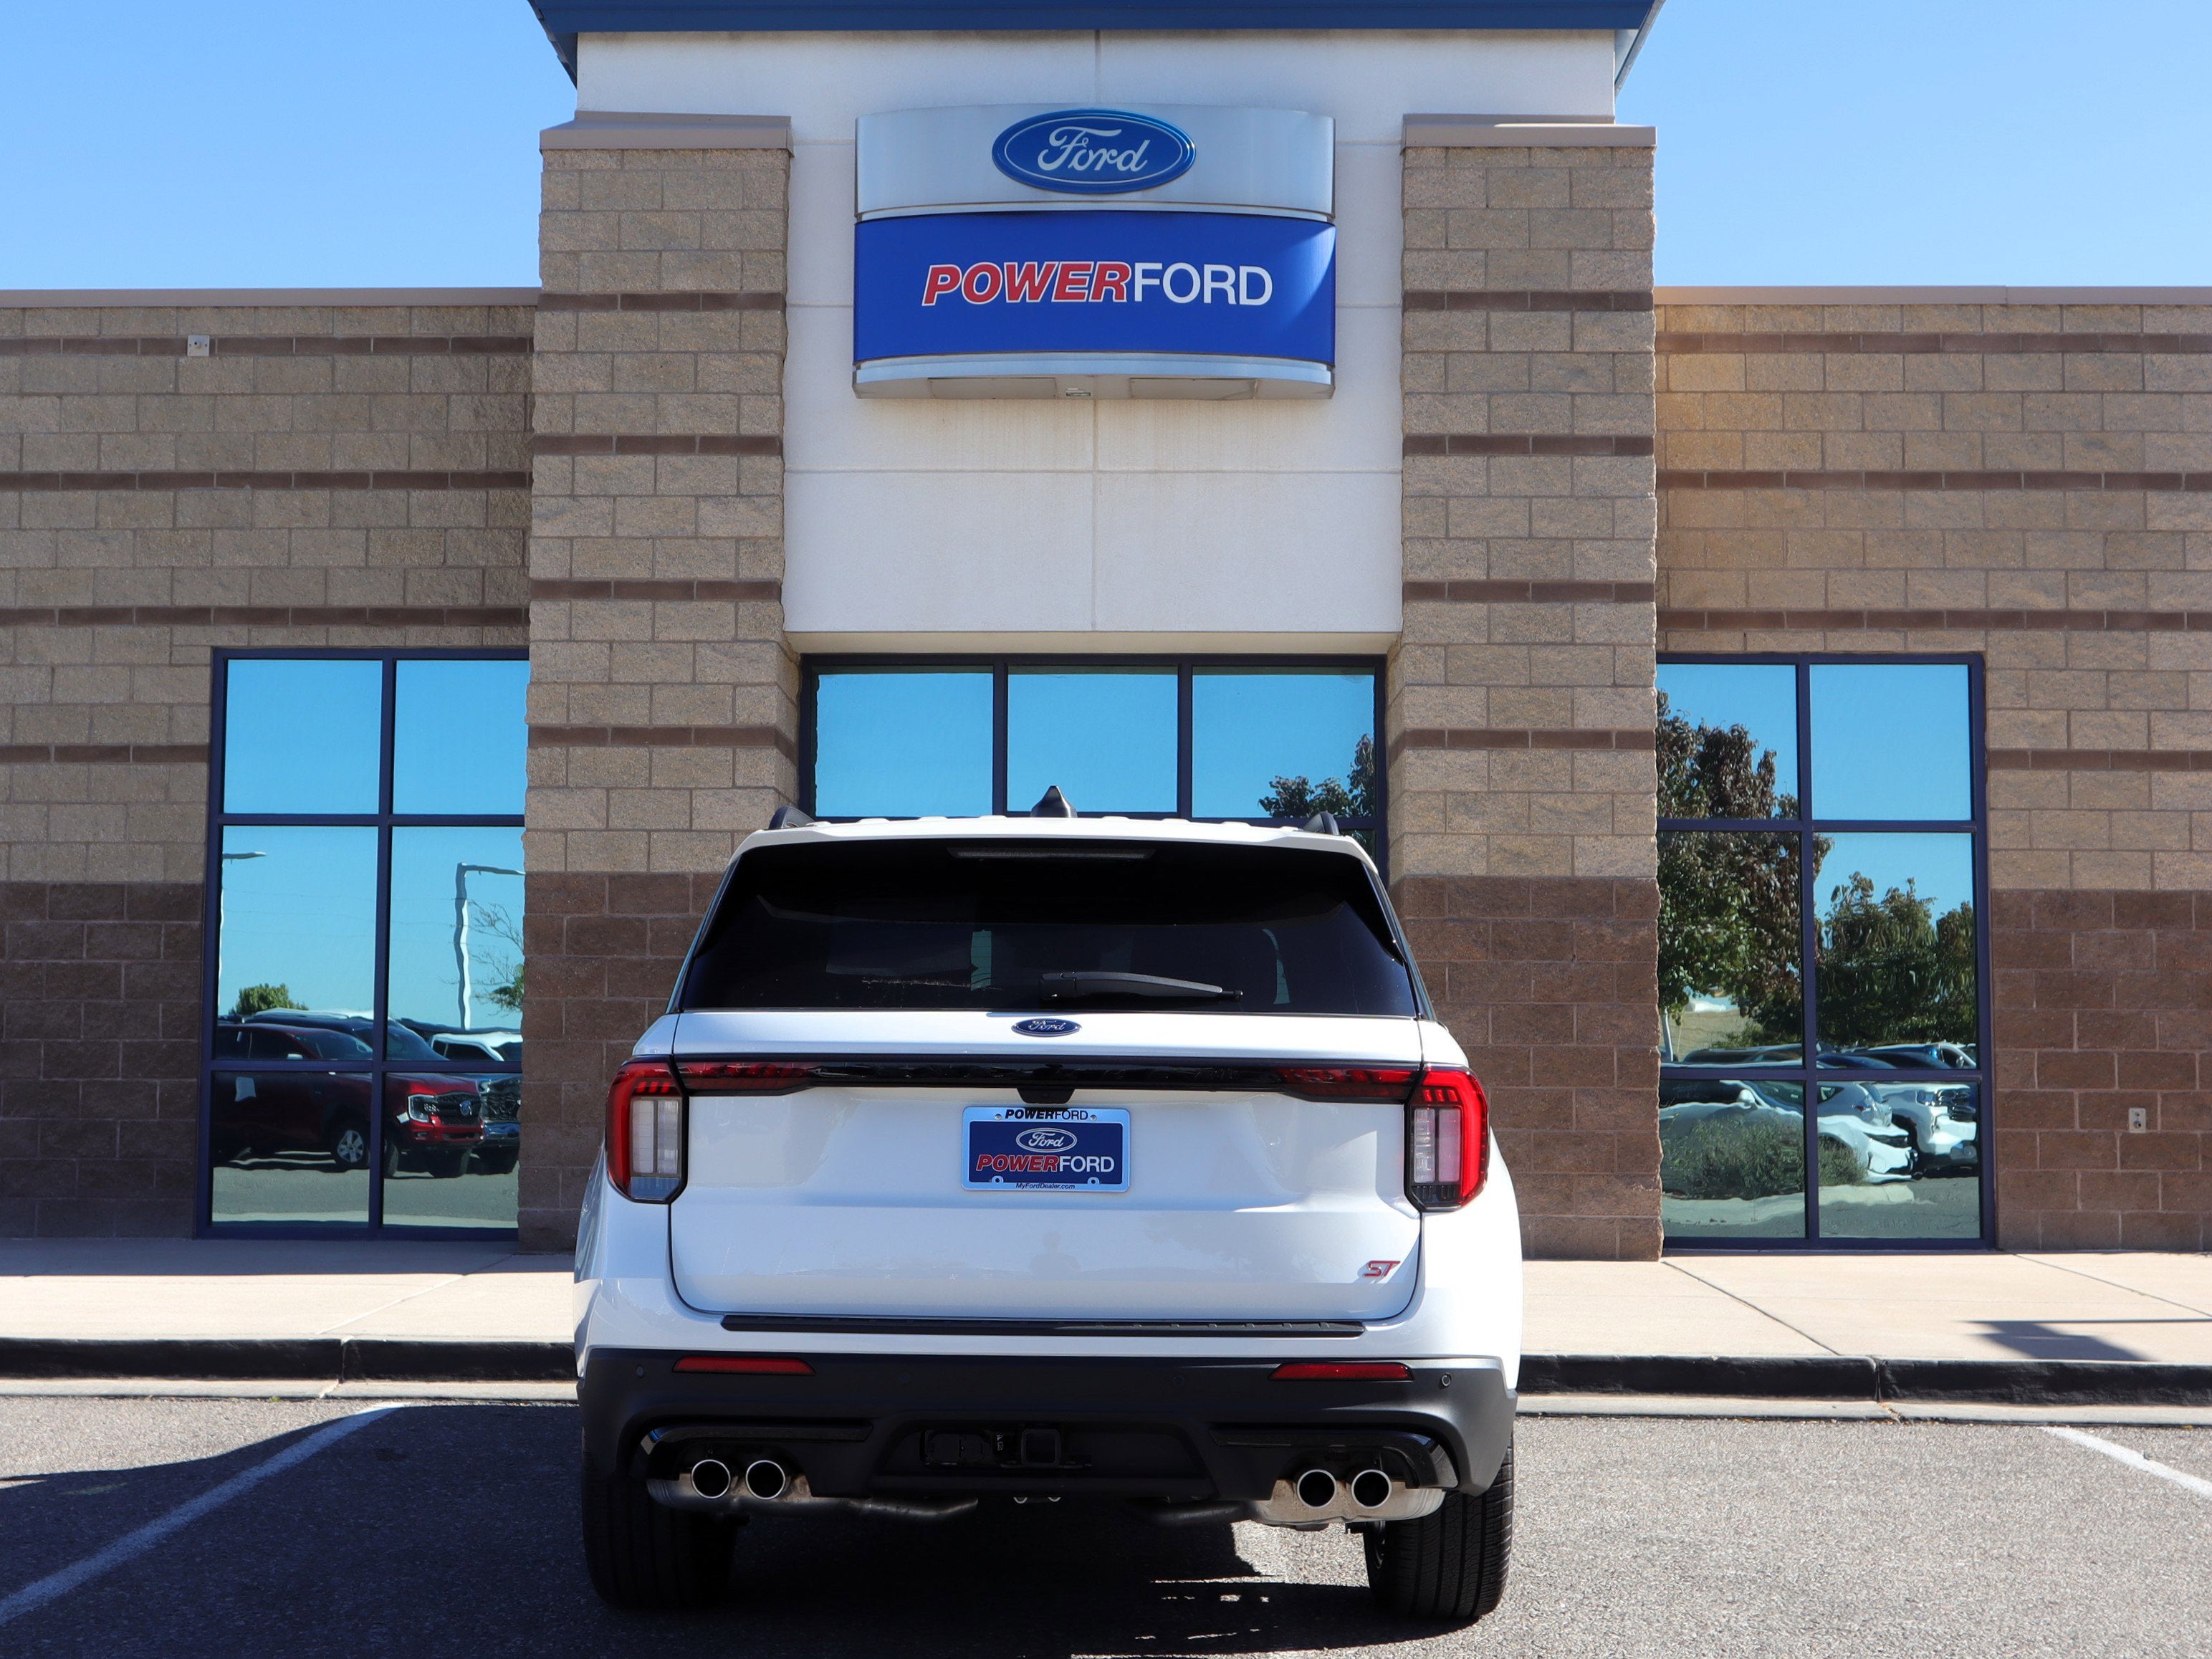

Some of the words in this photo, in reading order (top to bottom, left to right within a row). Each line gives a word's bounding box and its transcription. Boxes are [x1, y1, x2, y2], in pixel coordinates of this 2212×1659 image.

[1036, 125, 1150, 173] Ford
[921, 261, 1273, 307] POWERFORD
[1028, 1020, 1066, 1031] Ford
[1028, 1132, 1064, 1147] Ford
[975, 1154, 1115, 1173] POWERFORD
[1363, 1260, 1401, 1278] ST
